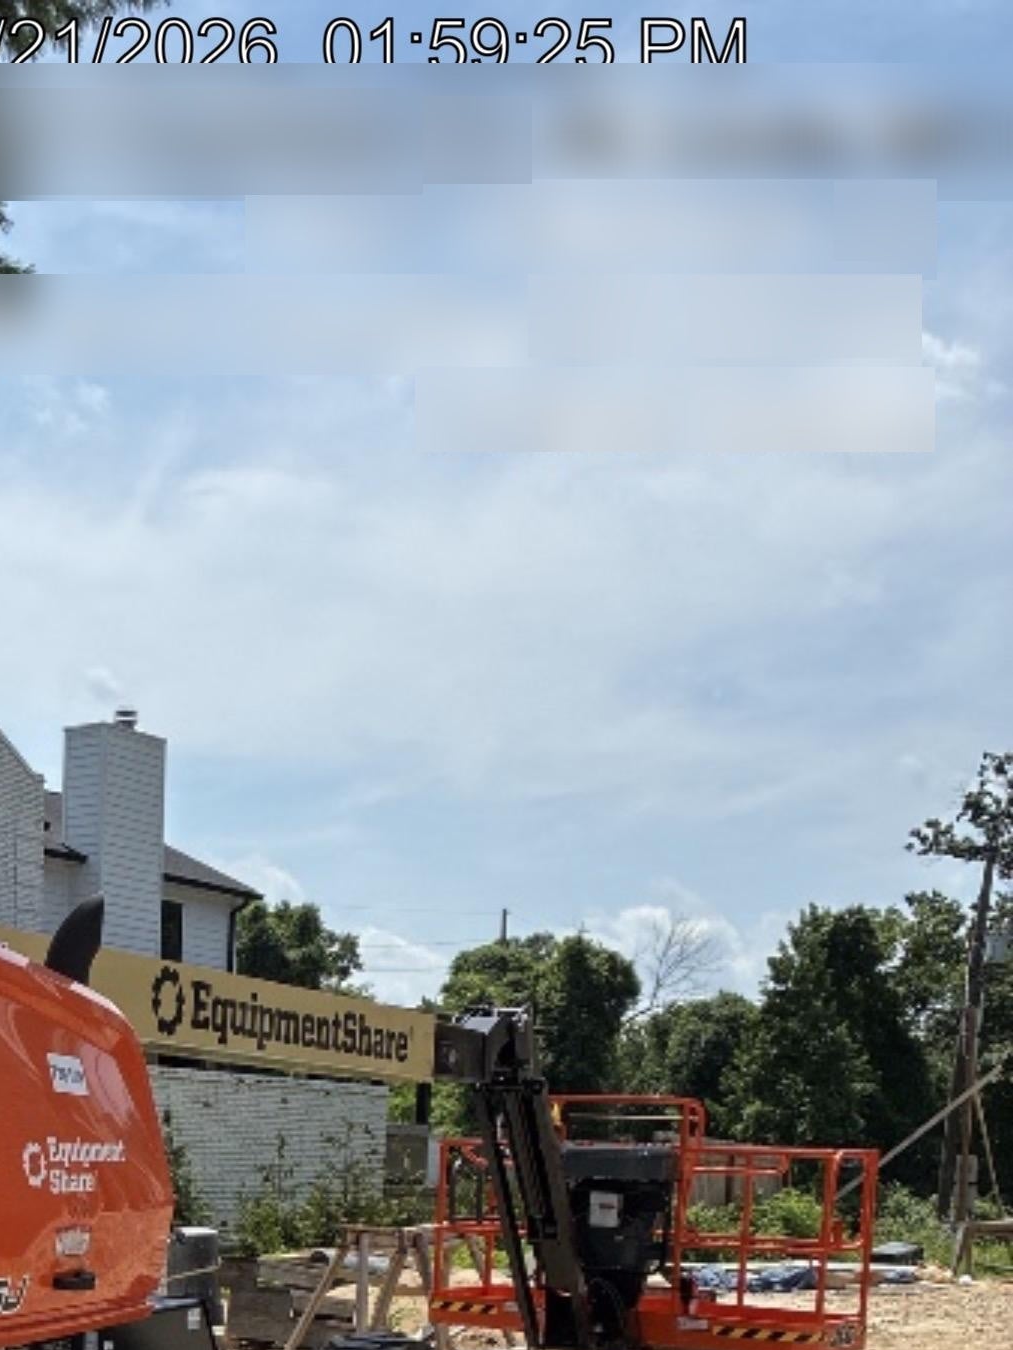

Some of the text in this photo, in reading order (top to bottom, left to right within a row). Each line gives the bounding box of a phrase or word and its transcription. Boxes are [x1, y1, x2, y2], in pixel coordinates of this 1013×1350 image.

[190, 979, 409, 1063] EquipmentShare
[46, 1136, 125, 1168] Equipment
[49, 1168, 95, 1195] Share
